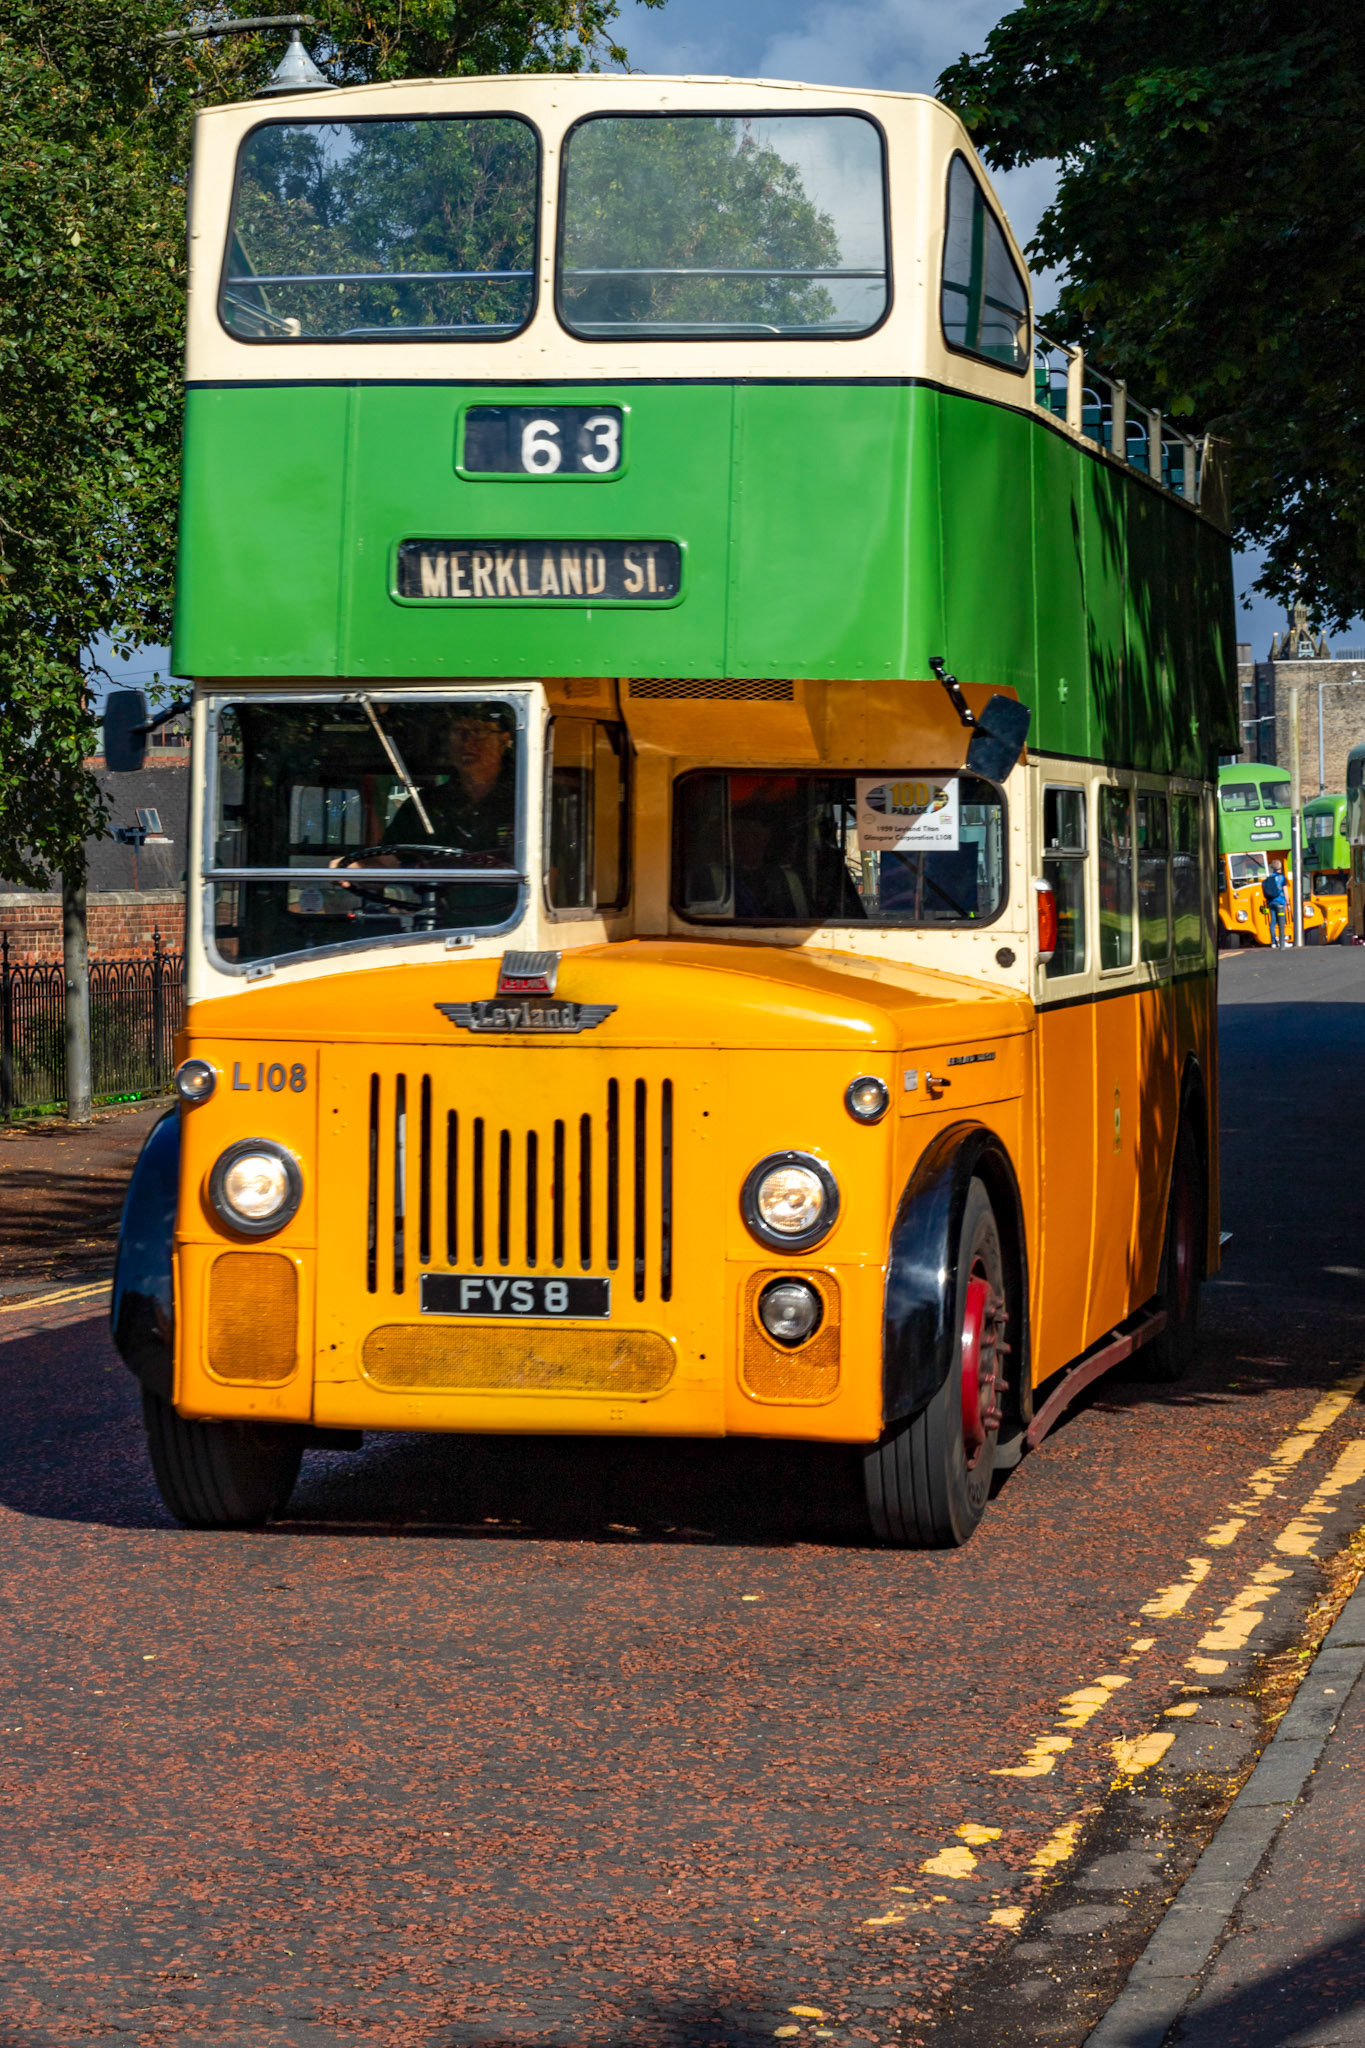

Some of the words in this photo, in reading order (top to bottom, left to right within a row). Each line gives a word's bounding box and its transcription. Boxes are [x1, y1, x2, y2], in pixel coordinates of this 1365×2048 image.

[420, 548, 606, 598] MERKLAND
[889, 782, 930, 807] 100
[864, 834, 893, 842] Glasgow
[895, 834, 934, 842] Corporation
[895, 825, 921, 833] Leyland
[475, 1001, 576, 1031] Leyland
[232, 1062, 307, 1093] L108
[460, 1279, 535, 1313] FYS
[544, 1281, 569, 1313] 8
